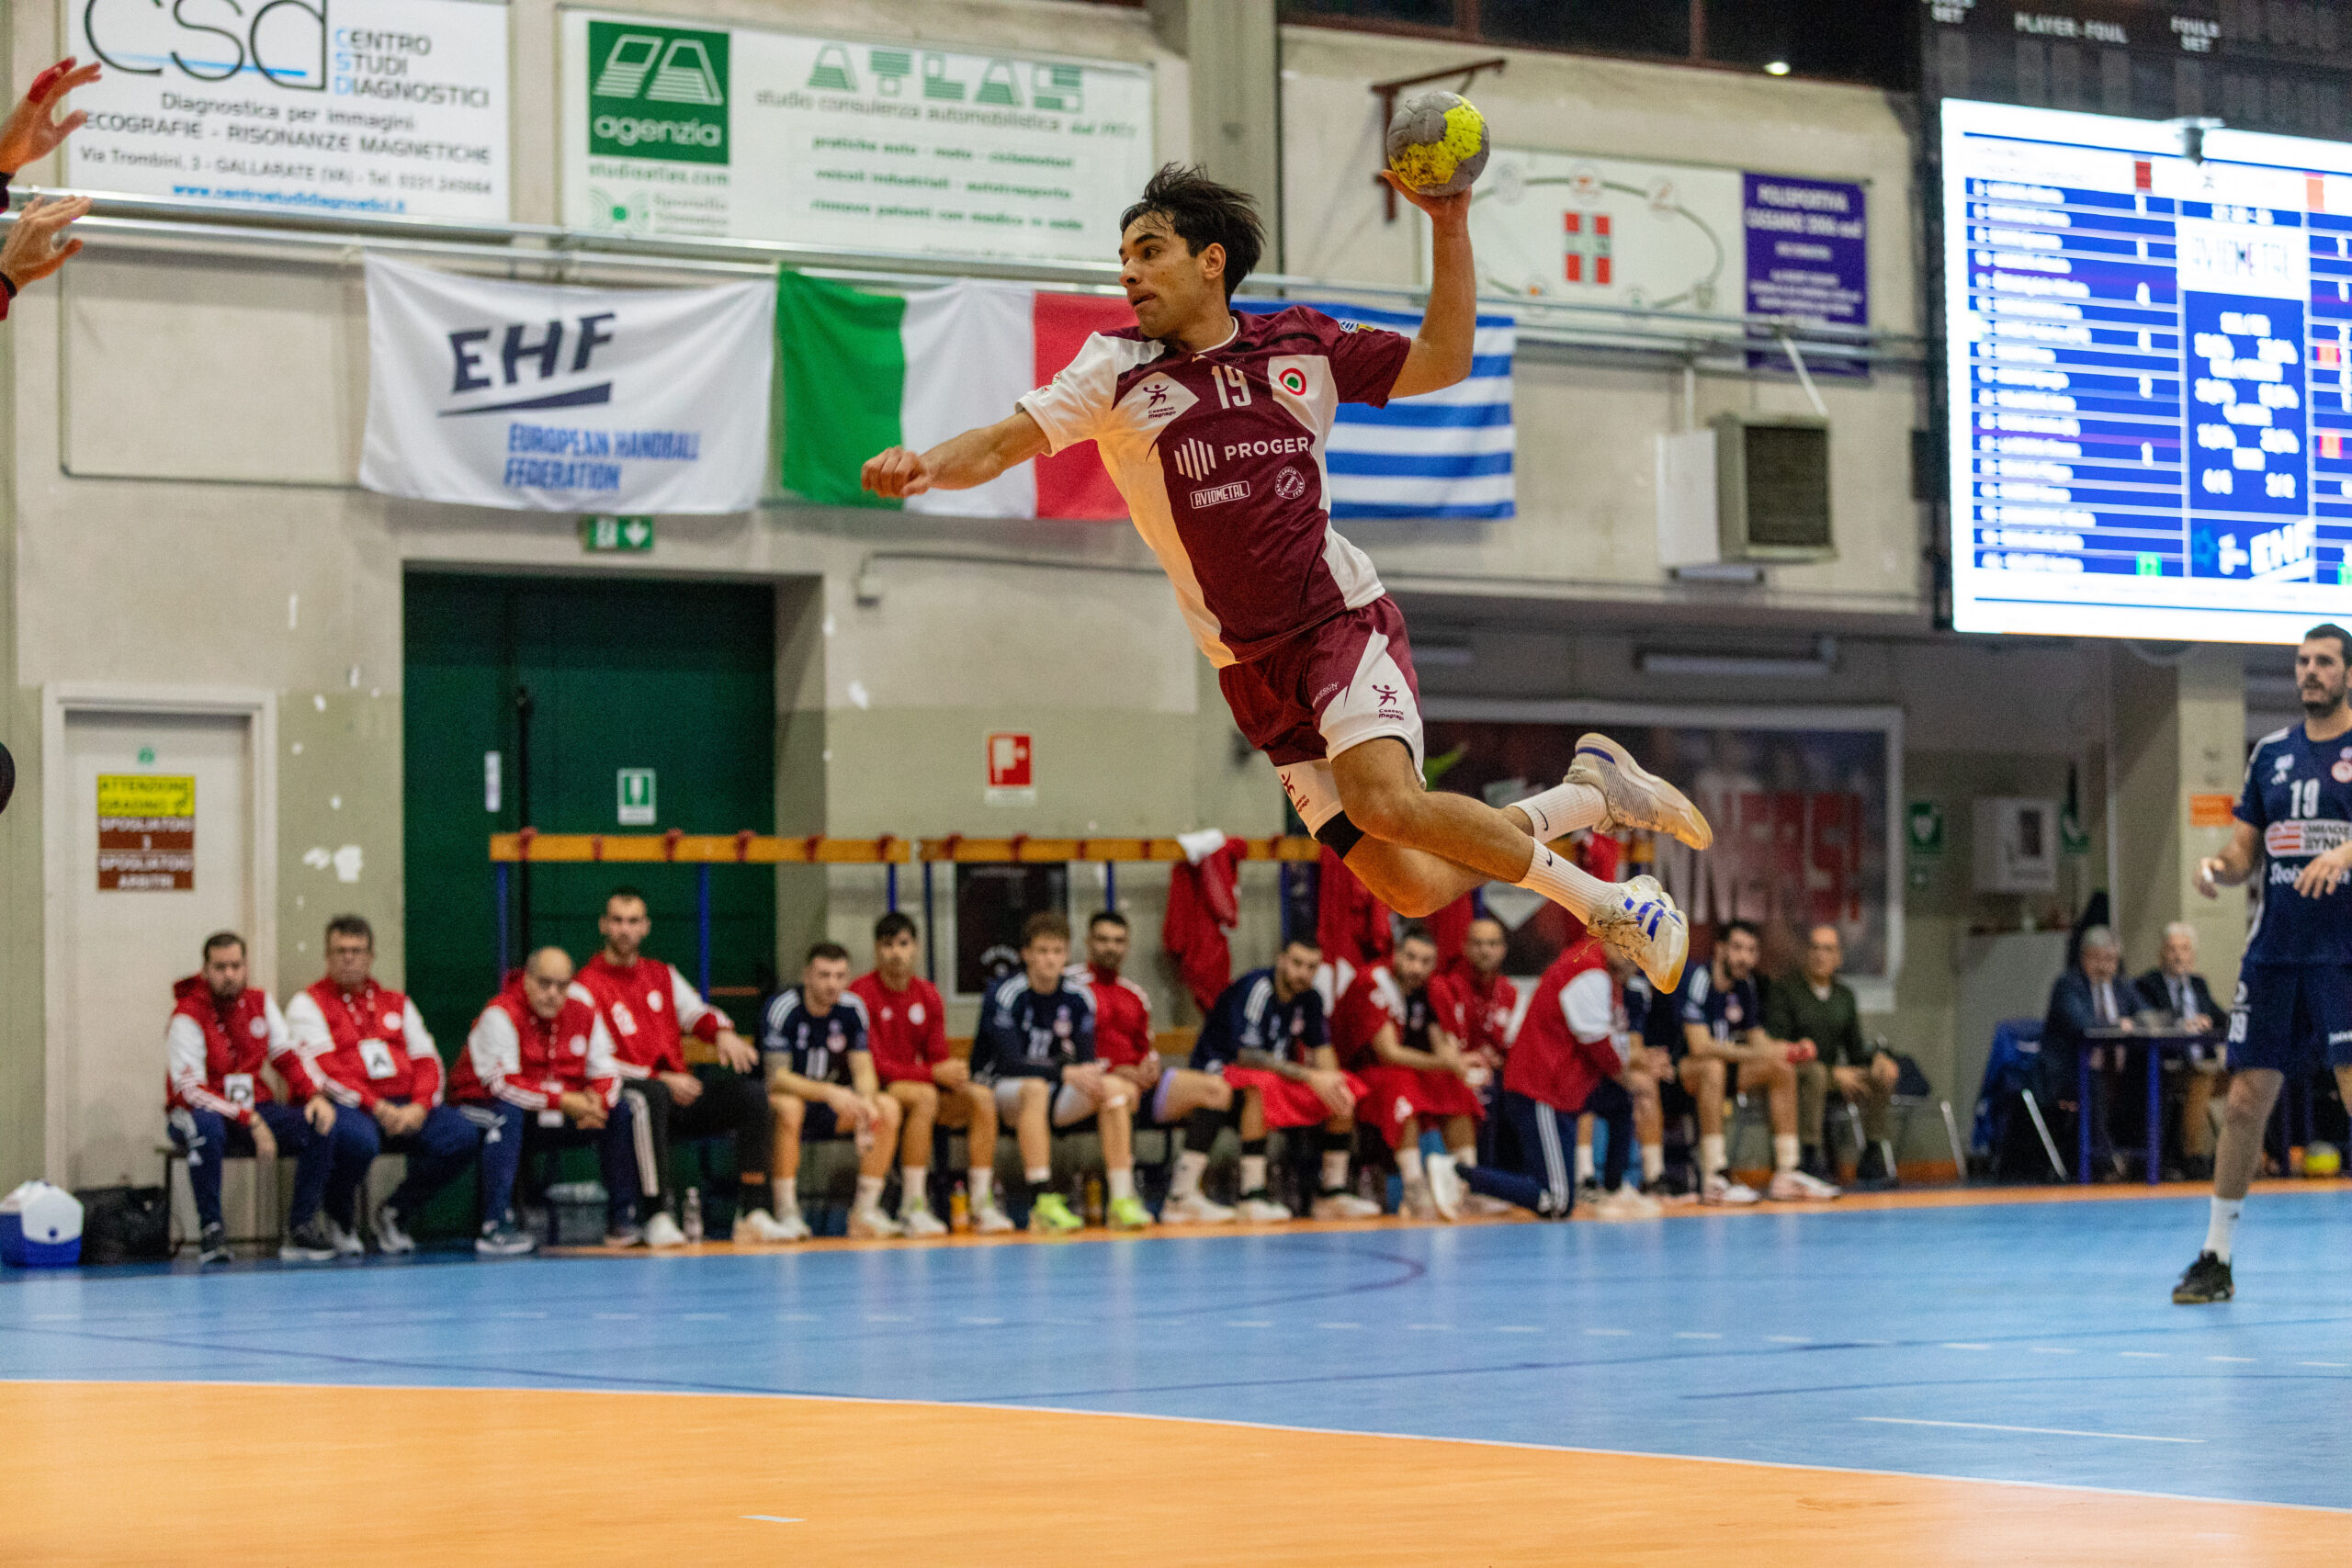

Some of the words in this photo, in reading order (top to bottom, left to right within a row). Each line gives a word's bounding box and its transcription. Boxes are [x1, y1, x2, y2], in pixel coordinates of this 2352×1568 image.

[334, 28, 432, 57] CENTRO
[334, 51, 409, 76] STUDI
[805, 39, 1085, 115] ATLAS
[334, 74, 491, 108] DIAGNOSTICI
[160, 91, 279, 118] Diagnostica
[287, 107, 318, 123] per
[326, 107, 415, 132] immagini
[84, 111, 204, 140] ECOGRAFIE
[227, 123, 351, 153] RISONANZE
[359, 136, 492, 166] MAGNETICHE
[593, 114, 723, 148] agenzia
[80, 146, 106, 164] Via
[215, 157, 315, 183] GALLARATE
[448, 313, 616, 393] EHF
[1211, 365, 1252, 410] 19
[507, 422, 612, 457] EUROPEAN
[614, 428, 701, 462] HANDBALL
[1224, 436, 1309, 461] PROGER
[504, 457, 623, 491] FEDERATION
[2290, 777, 2321, 819] 19
